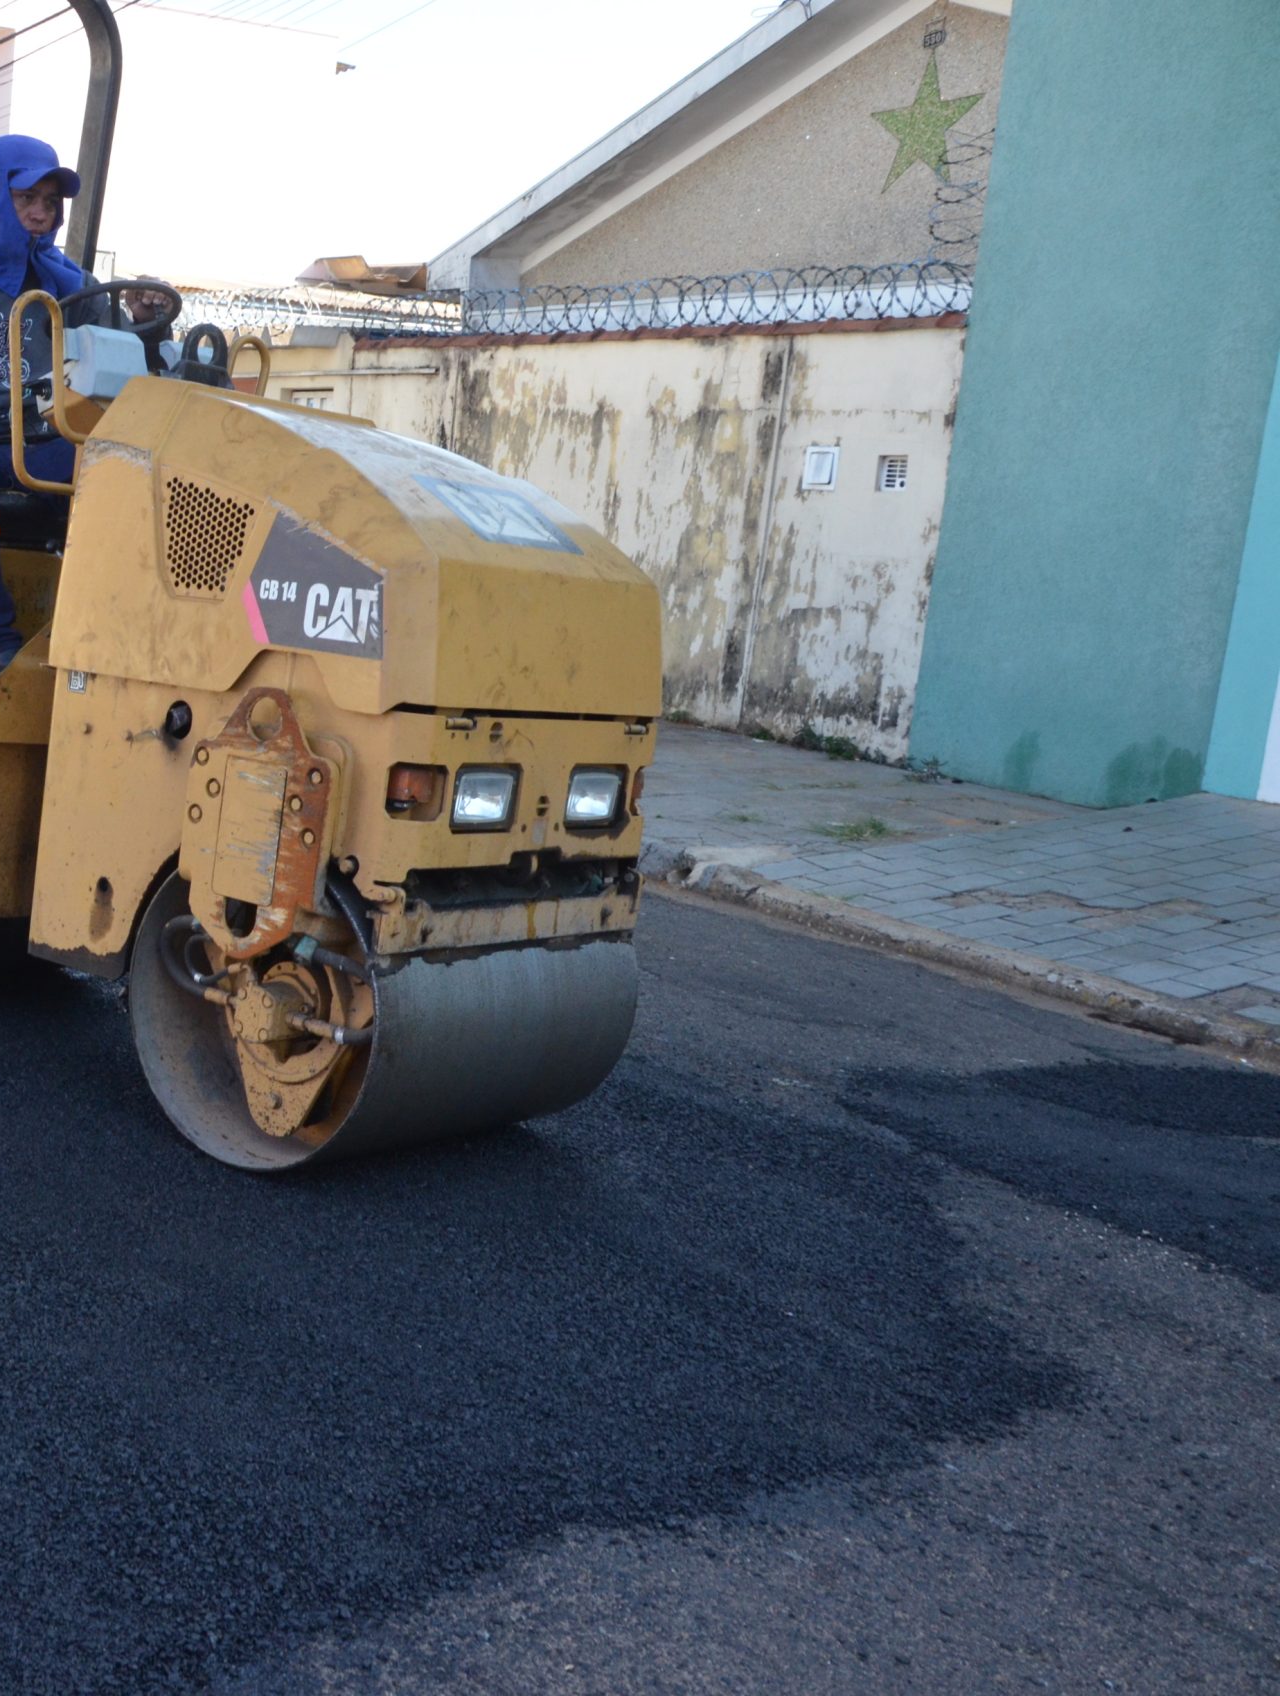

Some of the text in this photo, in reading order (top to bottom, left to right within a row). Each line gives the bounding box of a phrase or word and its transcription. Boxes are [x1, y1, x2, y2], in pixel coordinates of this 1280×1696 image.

[259, 578, 298, 603] CB 14
[303, 582, 379, 645] CAT
